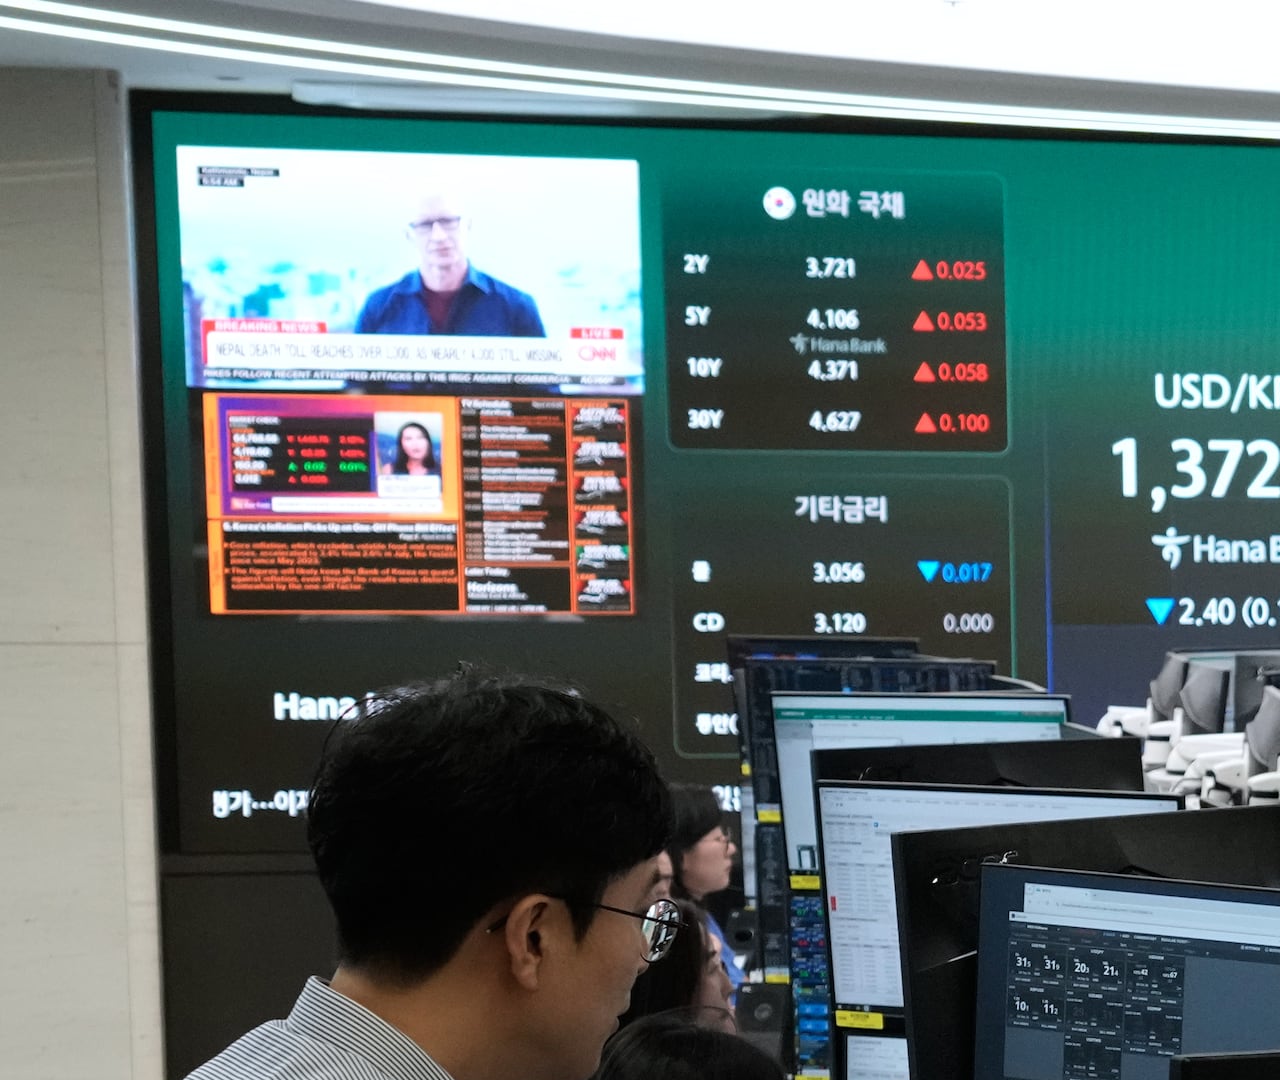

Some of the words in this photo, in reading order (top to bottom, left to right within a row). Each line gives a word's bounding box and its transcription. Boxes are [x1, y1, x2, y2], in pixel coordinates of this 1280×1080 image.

[802, 188, 851, 217] 원화
[857, 190, 905, 219] 국채
[683, 254, 709, 274] 2Y
[805, 257, 856, 278] 3.721
[936, 260, 987, 281] 0.025
[215, 321, 277, 332] BREAKING
[281, 322, 318, 333] NEWS
[684, 305, 711, 326] 5Y
[807, 309, 859, 330] 4.106
[937, 312, 988, 332] 0.053
[581, 328, 611, 338] LIVE
[216, 343, 245, 356] NEPAL
[578, 346, 616, 361] CNN
[811, 338, 848, 353] Hana
[850, 338, 887, 354] Bank
[233, 369, 272, 378] FOLLOW
[275, 370, 311, 380] RECENT
[313, 370, 367, 380] ATTEMPTED
[369, 371, 411, 382] ATTACKS
[429, 373, 447, 382] THE
[472, 373, 512, 383] AGAINST
[687, 357, 722, 378] 10Y
[807, 360, 858, 381] 4.371
[938, 363, 989, 383] 0.058
[687, 409, 724, 430] 30Y
[809, 411, 861, 433] 4.627
[939, 413, 990, 434] 0.100
[795, 496, 888, 524] 기타금리
[1193, 534, 1266, 563] Hana
[813, 562, 865, 584] 3.056
[942, 563, 993, 584] 0.017
[693, 612, 725, 633] CD
[814, 612, 867, 634] 3.120
[943, 613, 994, 634] 0.000
[1178, 598, 1235, 626] 2.40
[273, 691, 359, 720] Hana
